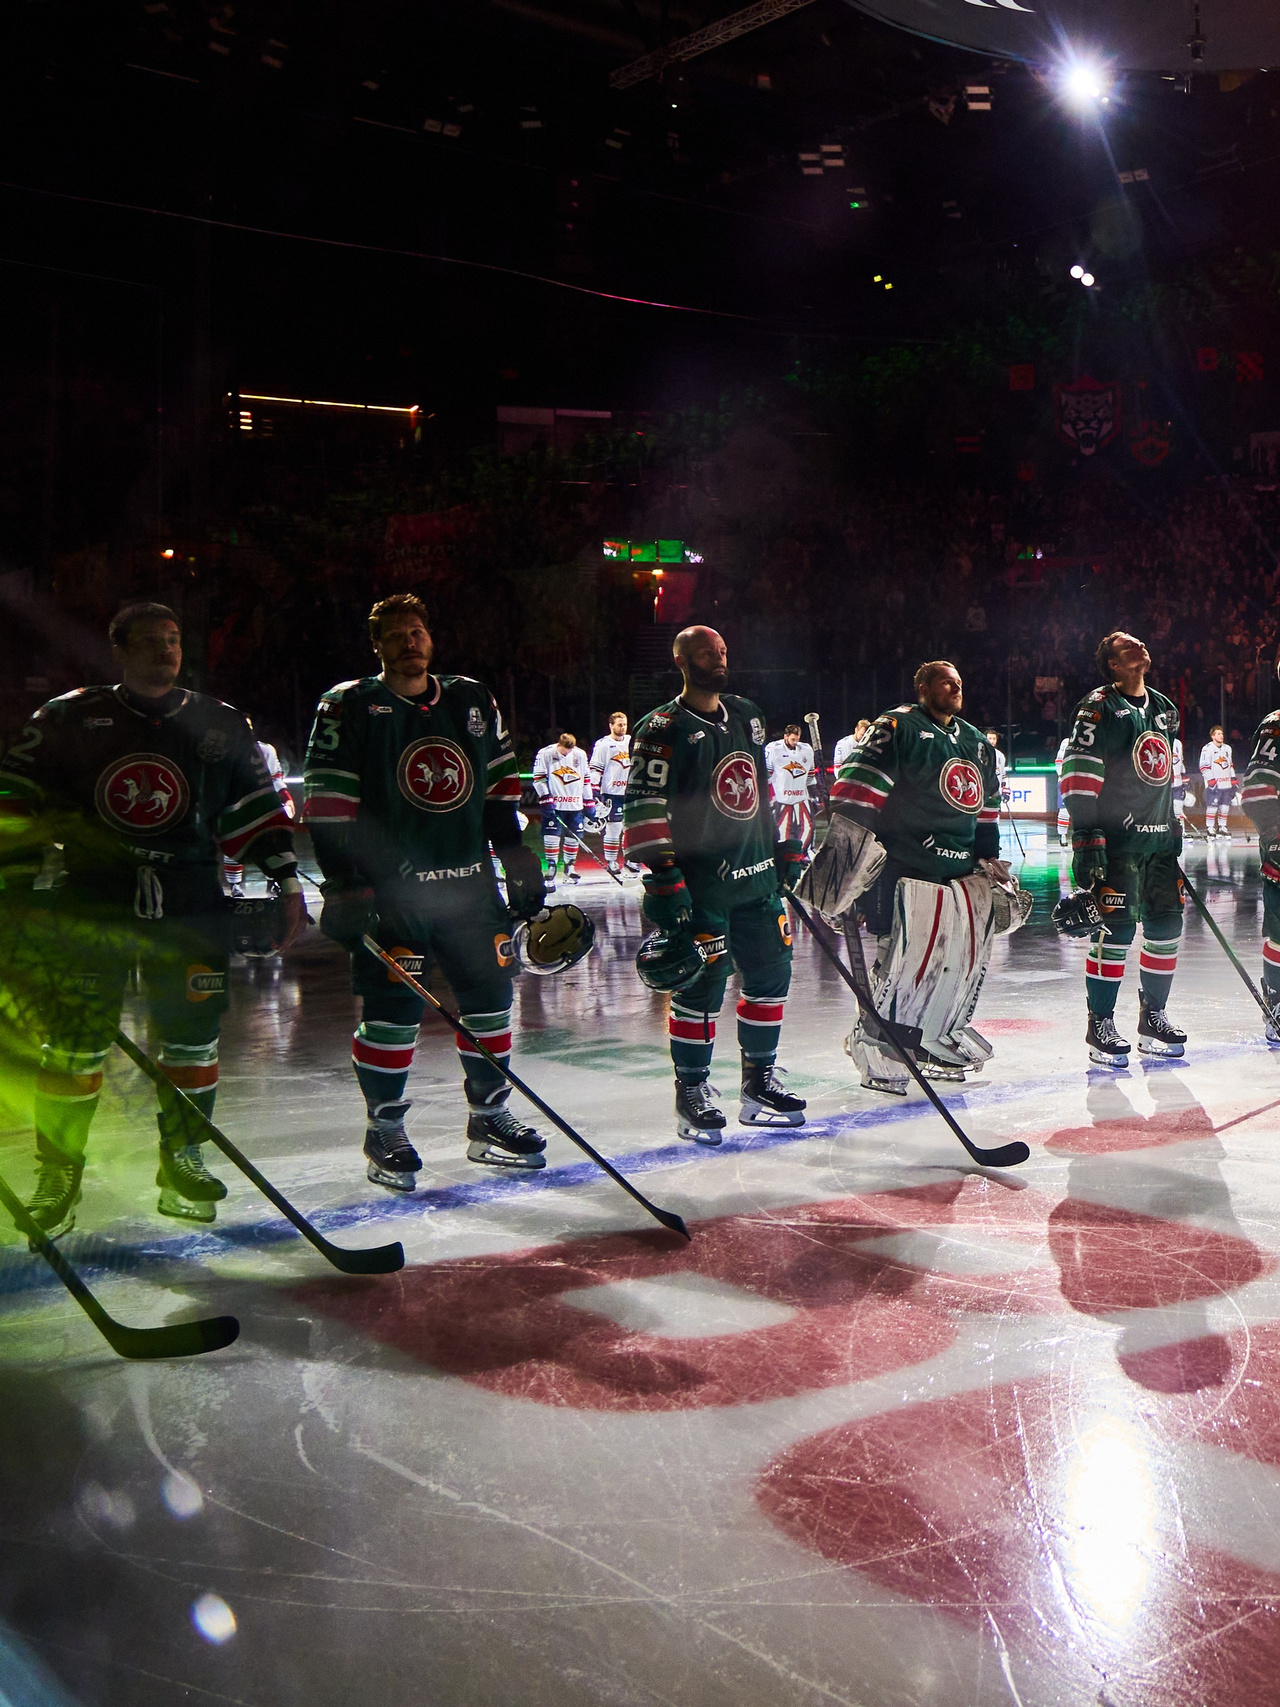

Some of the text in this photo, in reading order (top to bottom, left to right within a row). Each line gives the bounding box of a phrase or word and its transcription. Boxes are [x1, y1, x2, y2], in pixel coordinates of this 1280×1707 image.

[859, 725, 892, 754] 82
[1251, 738, 1277, 761] 4
[628, 755, 670, 788] 29
[1135, 823, 1169, 833] TATNE
[416, 862, 483, 883] TATNEFT
[731, 857, 775, 880] TATNEFT
[1105, 896, 1125, 905] WIN
[704, 940, 725, 953] WIN
[400, 958, 423, 971] WIN
[198, 976, 223, 989] WIN
